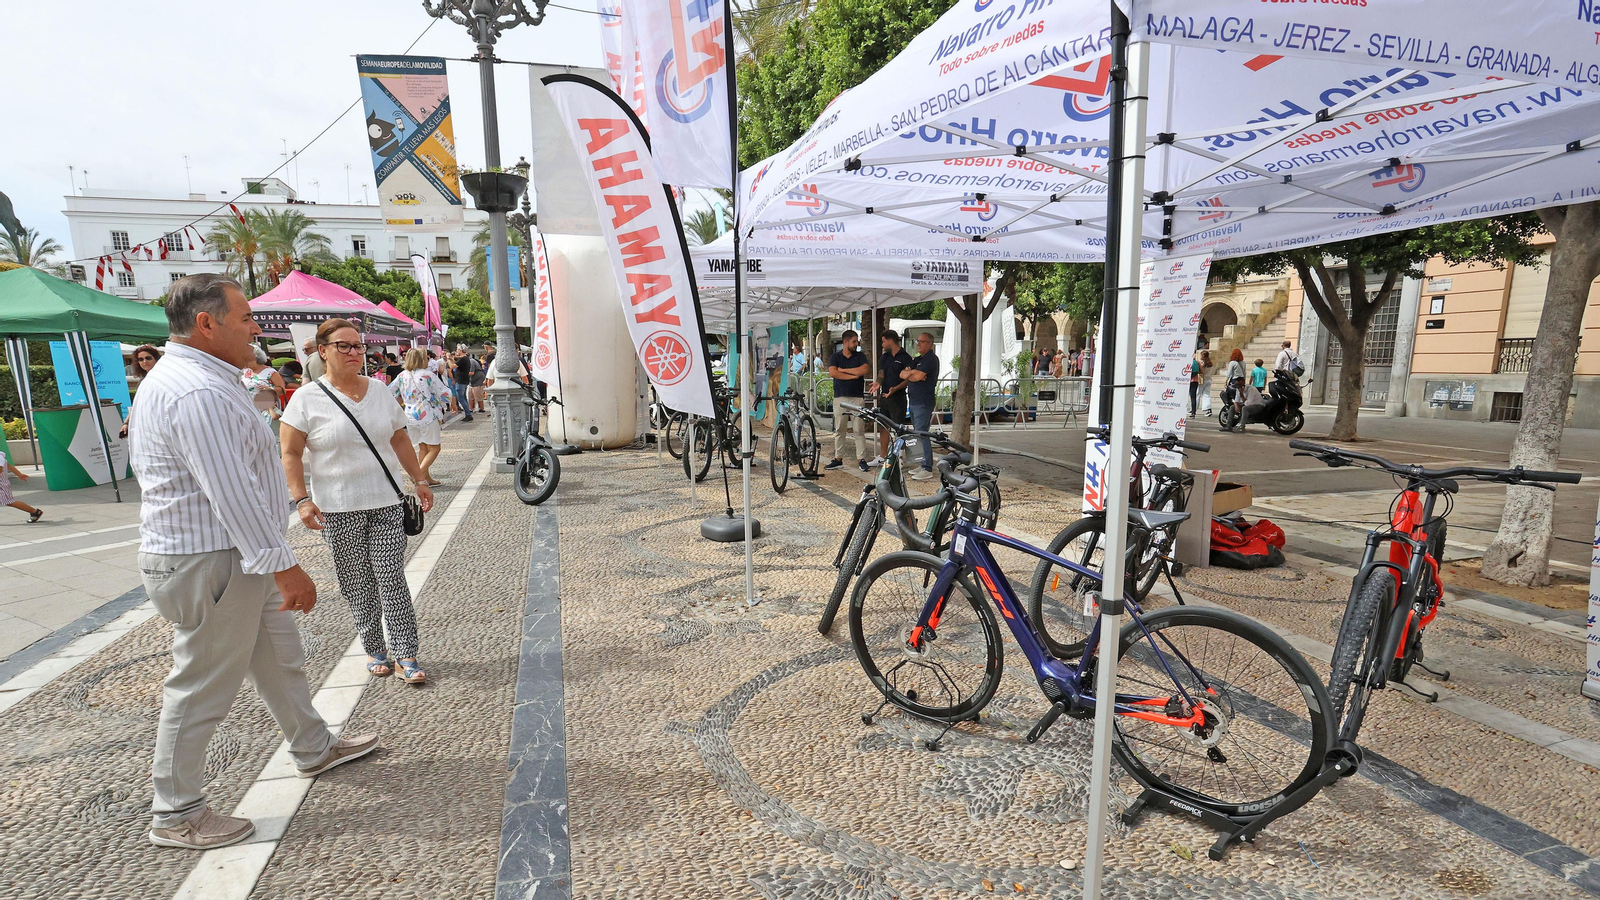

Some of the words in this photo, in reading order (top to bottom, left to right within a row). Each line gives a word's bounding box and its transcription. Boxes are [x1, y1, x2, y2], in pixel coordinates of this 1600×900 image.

[928, 4, 1016, 66] Navarro
[938, 58, 962, 78] Todo
[964, 42, 999, 64] sobre
[1001, 20, 1045, 49] ruedas
[1146, 13, 1254, 44] MALAGA
[1274, 22, 1350, 53] JEREZ
[1367, 33, 1450, 65] SEVILLA
[1466, 45, 1550, 78] GRANADA
[377, 152, 405, 180] COMPARTIR
[402, 146, 412, 154] TE
[408, 134, 424, 148] LLEVA
[422, 122, 435, 135] MÁS
[433, 107, 447, 124] LEJOS
[805, 150, 828, 174] VÉLEZ
[833, 123, 884, 160] MARBELLA
[890, 111, 918, 132] SAN
[920, 83, 970, 120] PEDRO
[975, 70, 999, 96] DE
[923, 261, 969, 273] YAMAHA
[1170, 800, 1202, 817] FEEDBACK
